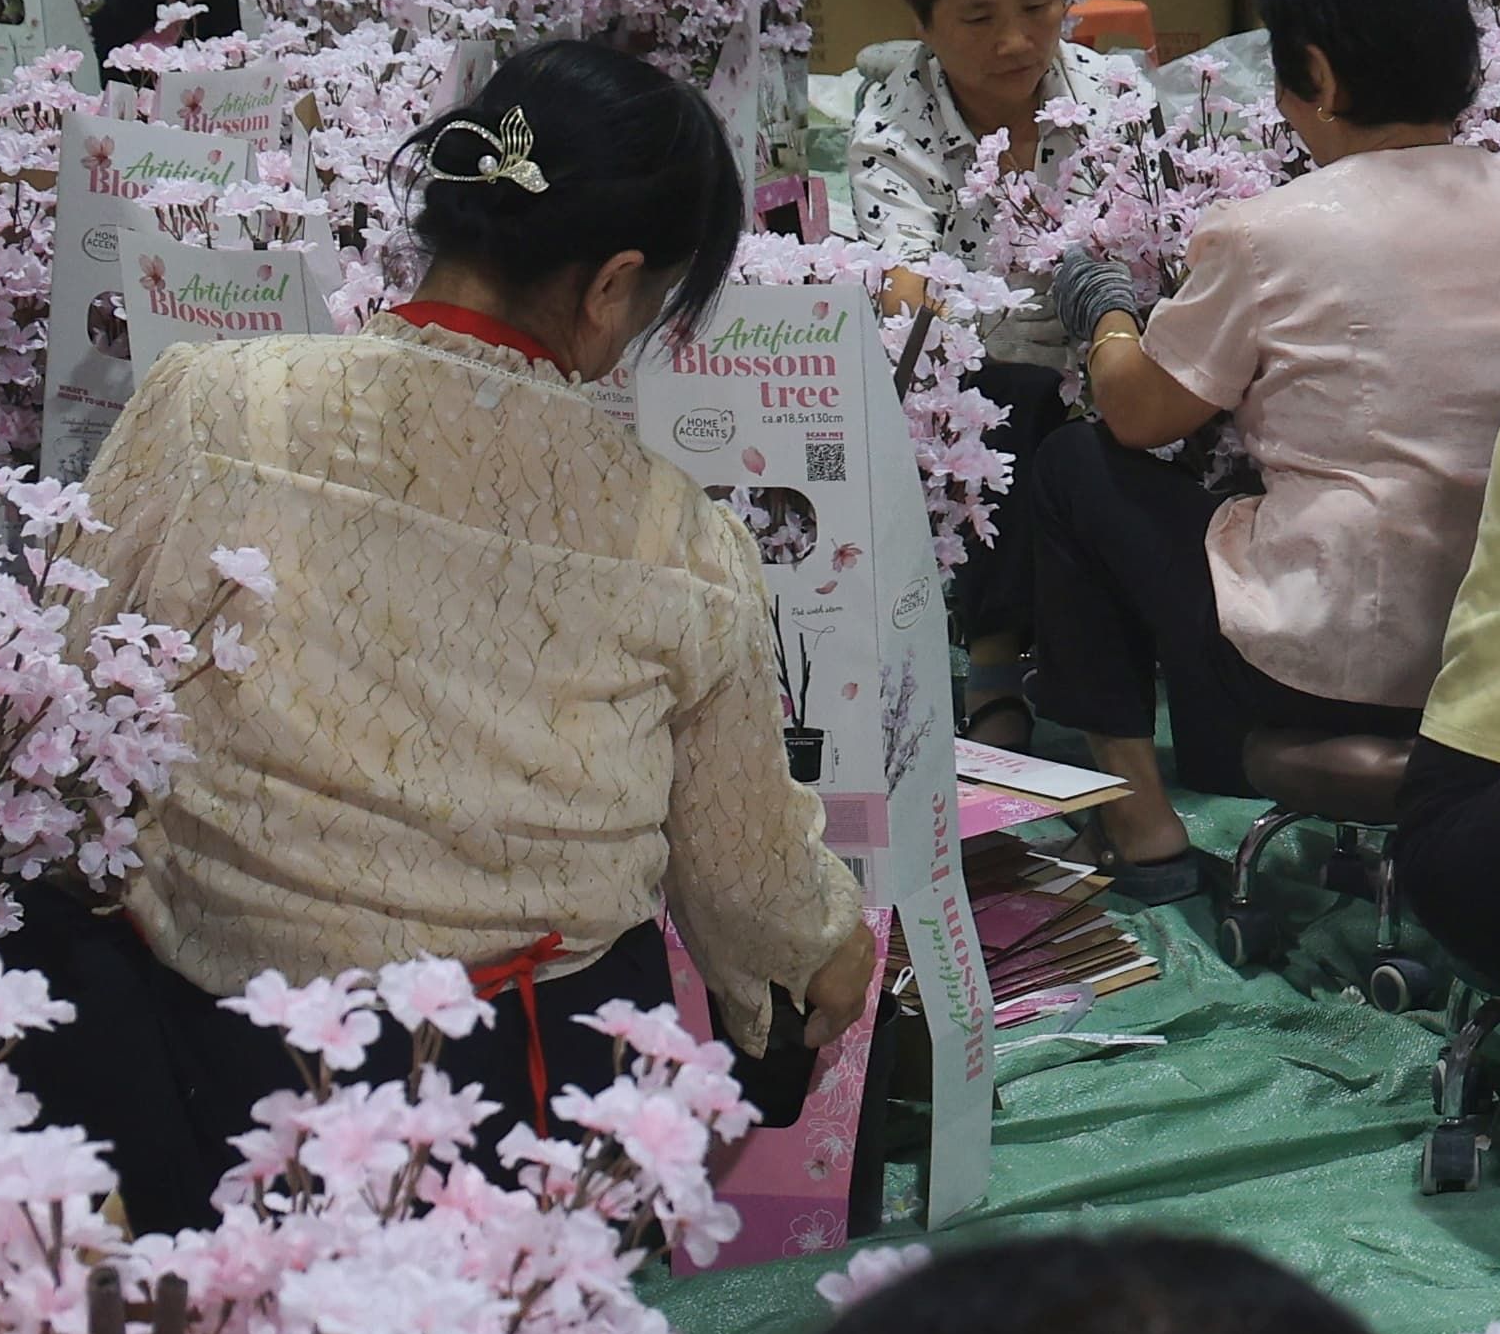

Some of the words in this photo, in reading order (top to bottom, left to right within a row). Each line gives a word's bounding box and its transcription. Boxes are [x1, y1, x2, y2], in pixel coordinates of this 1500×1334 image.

[211, 83, 278, 119] Artificial
[86, 238, 117, 250] ACCEN
[178, 273, 290, 312] Artificial
[149, 289, 283, 331] Blossom
[708, 311, 849, 355] Artificial
[670, 343, 837, 377] Blossom
[758, 381, 840, 408] tree
[678, 427, 728, 439] ACCENTS
[686, 418, 719, 429] HOME
[895, 597, 925, 617] ACCENTS
[900, 590, 921, 605] HOME
[931, 792, 951, 893] Tree
[942, 895, 984, 1083] Blossom
